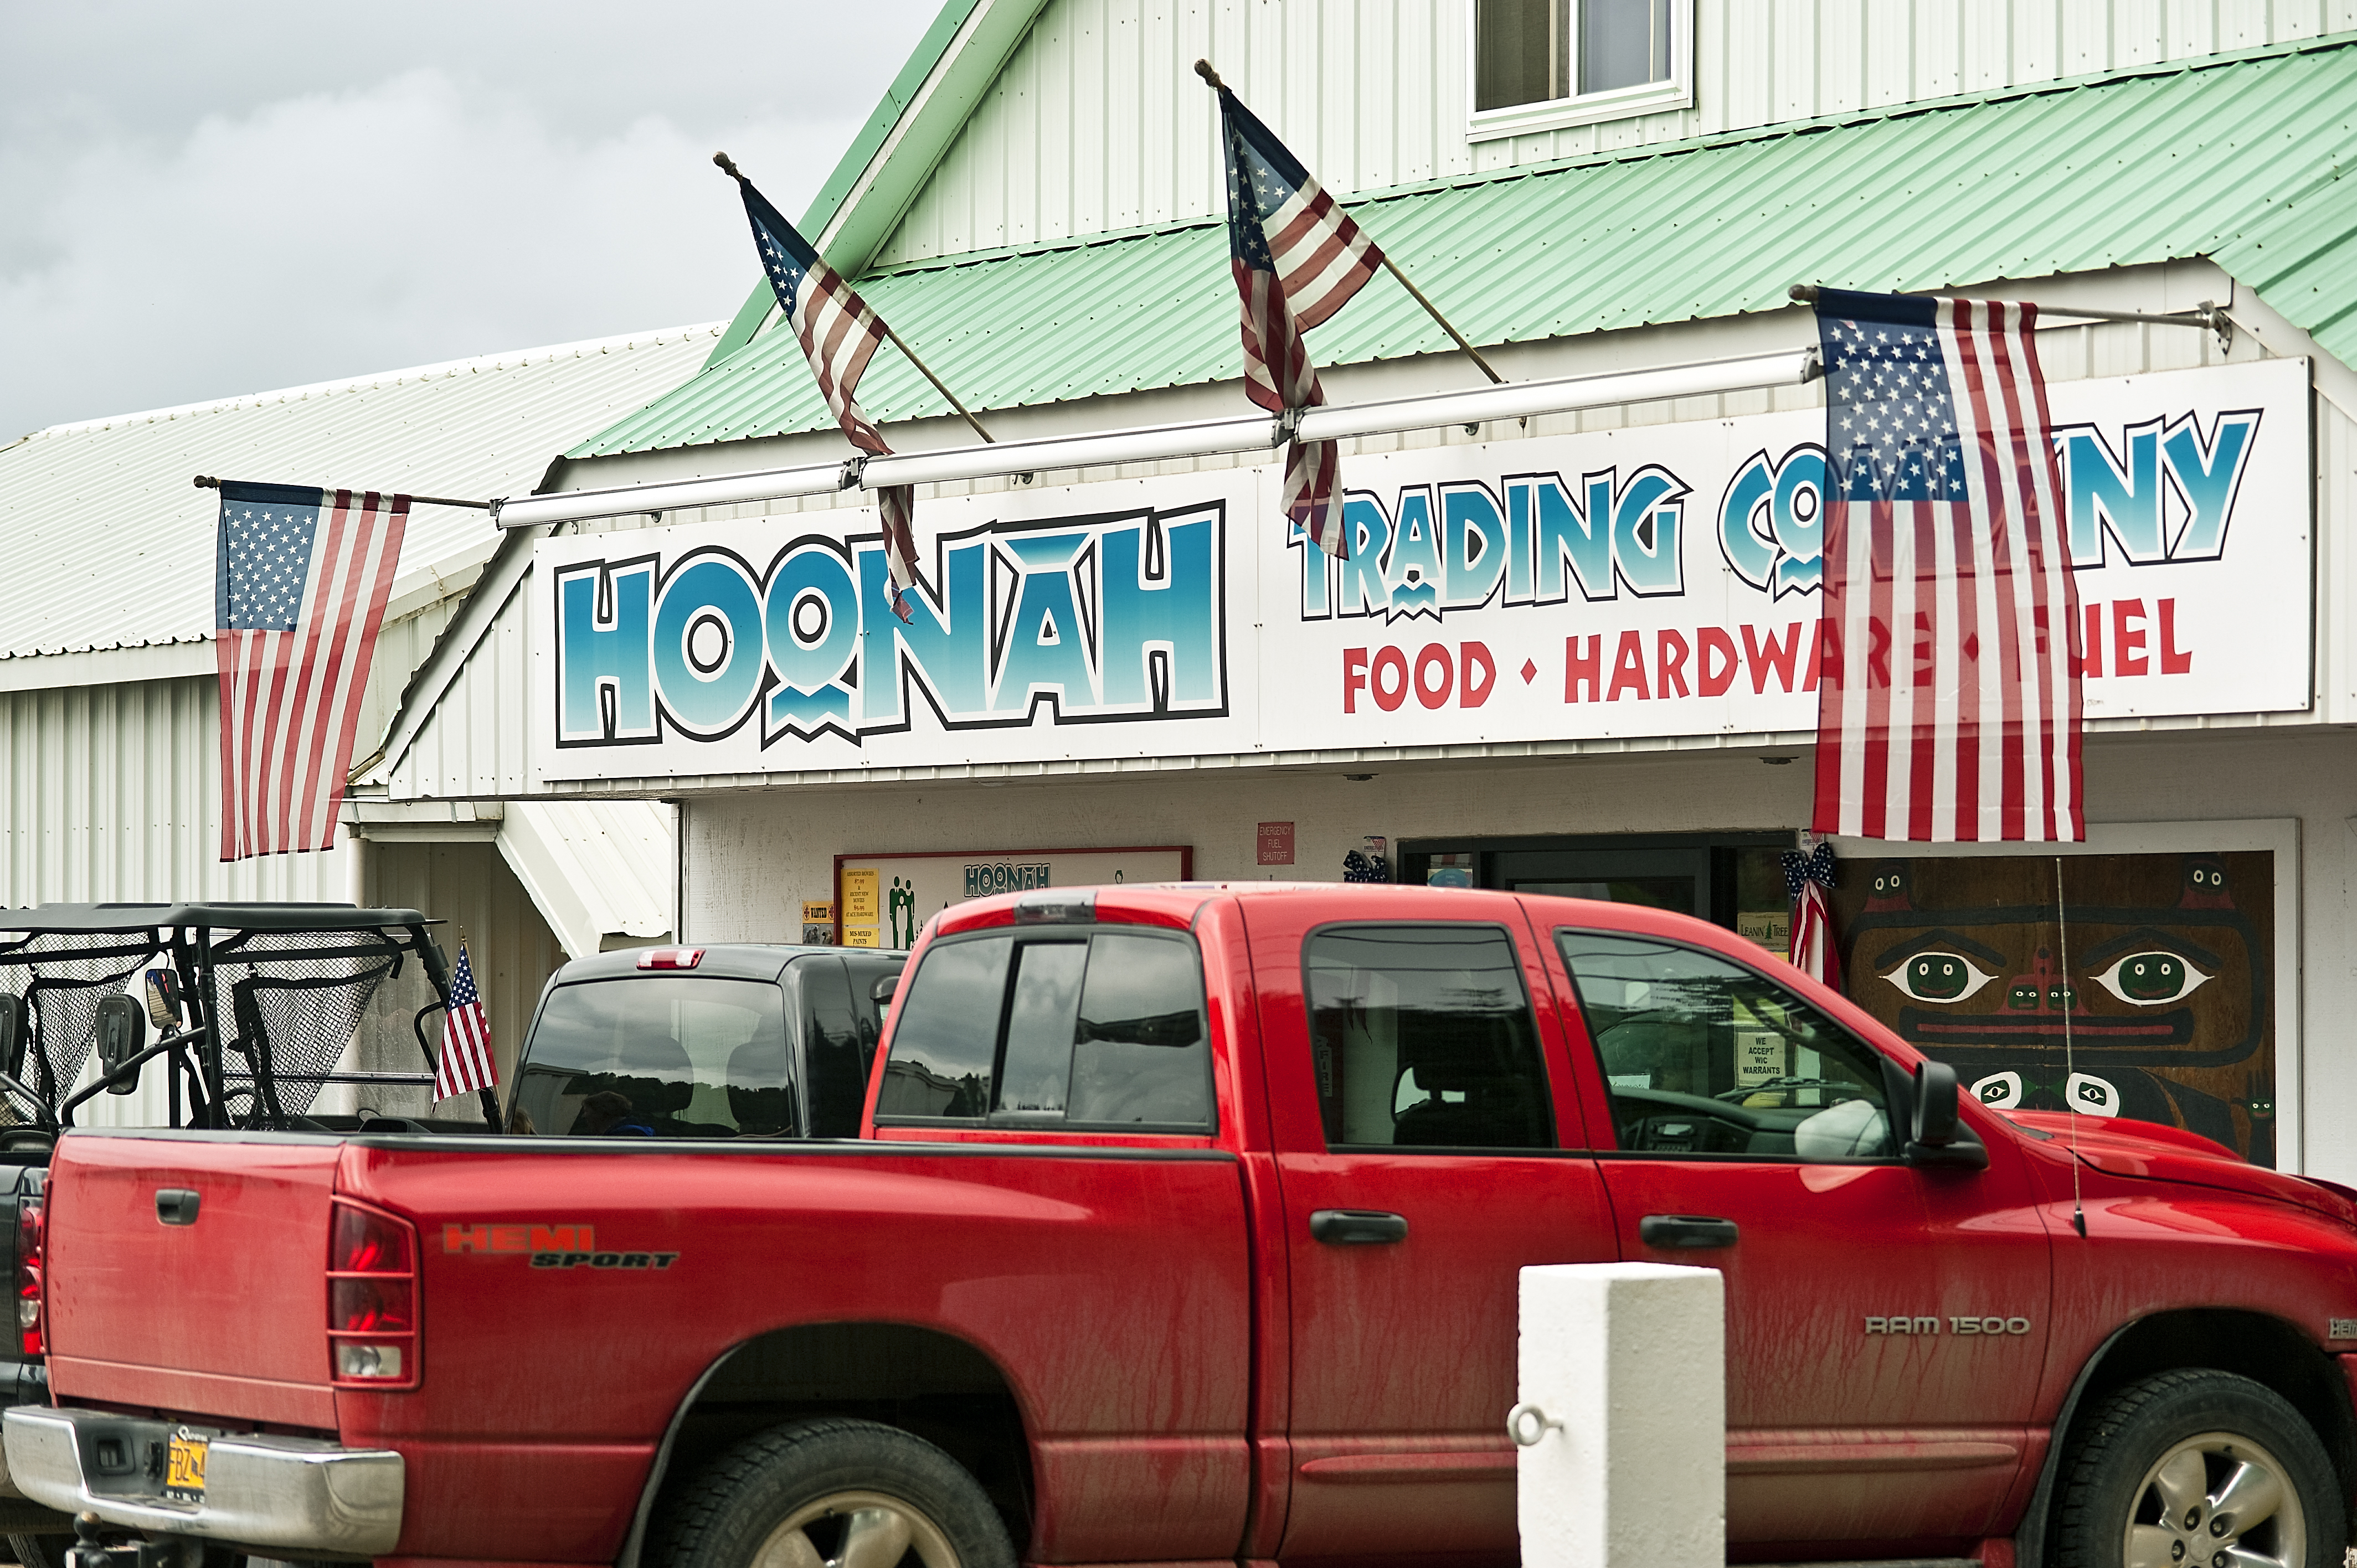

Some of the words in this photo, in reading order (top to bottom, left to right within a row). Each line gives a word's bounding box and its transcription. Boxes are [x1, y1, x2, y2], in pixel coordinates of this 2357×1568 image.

[1286, 463, 1693, 625] TRADING
[1715, 409, 2264, 602] COMPANY
[555, 499, 1229, 752] HOONAH
[1343, 641, 1496, 714] FOOD
[1565, 611, 1932, 704] HARDWARE
[1259, 826, 1291, 835] EMERGENCY
[1268, 839, 1282, 848] FUEL
[1263, 852, 1288, 861] SHUTOFF
[964, 863, 1051, 898] HOONAH
[811, 907, 827, 919] WANTED
[1773, 924, 1788, 936] TREE
[444, 1224, 594, 1254] HEMI
[529, 1251, 680, 1270] SPORT
[1865, 1316, 1940, 1334] RAM
[1948, 1316, 2031, 1335] 1500
